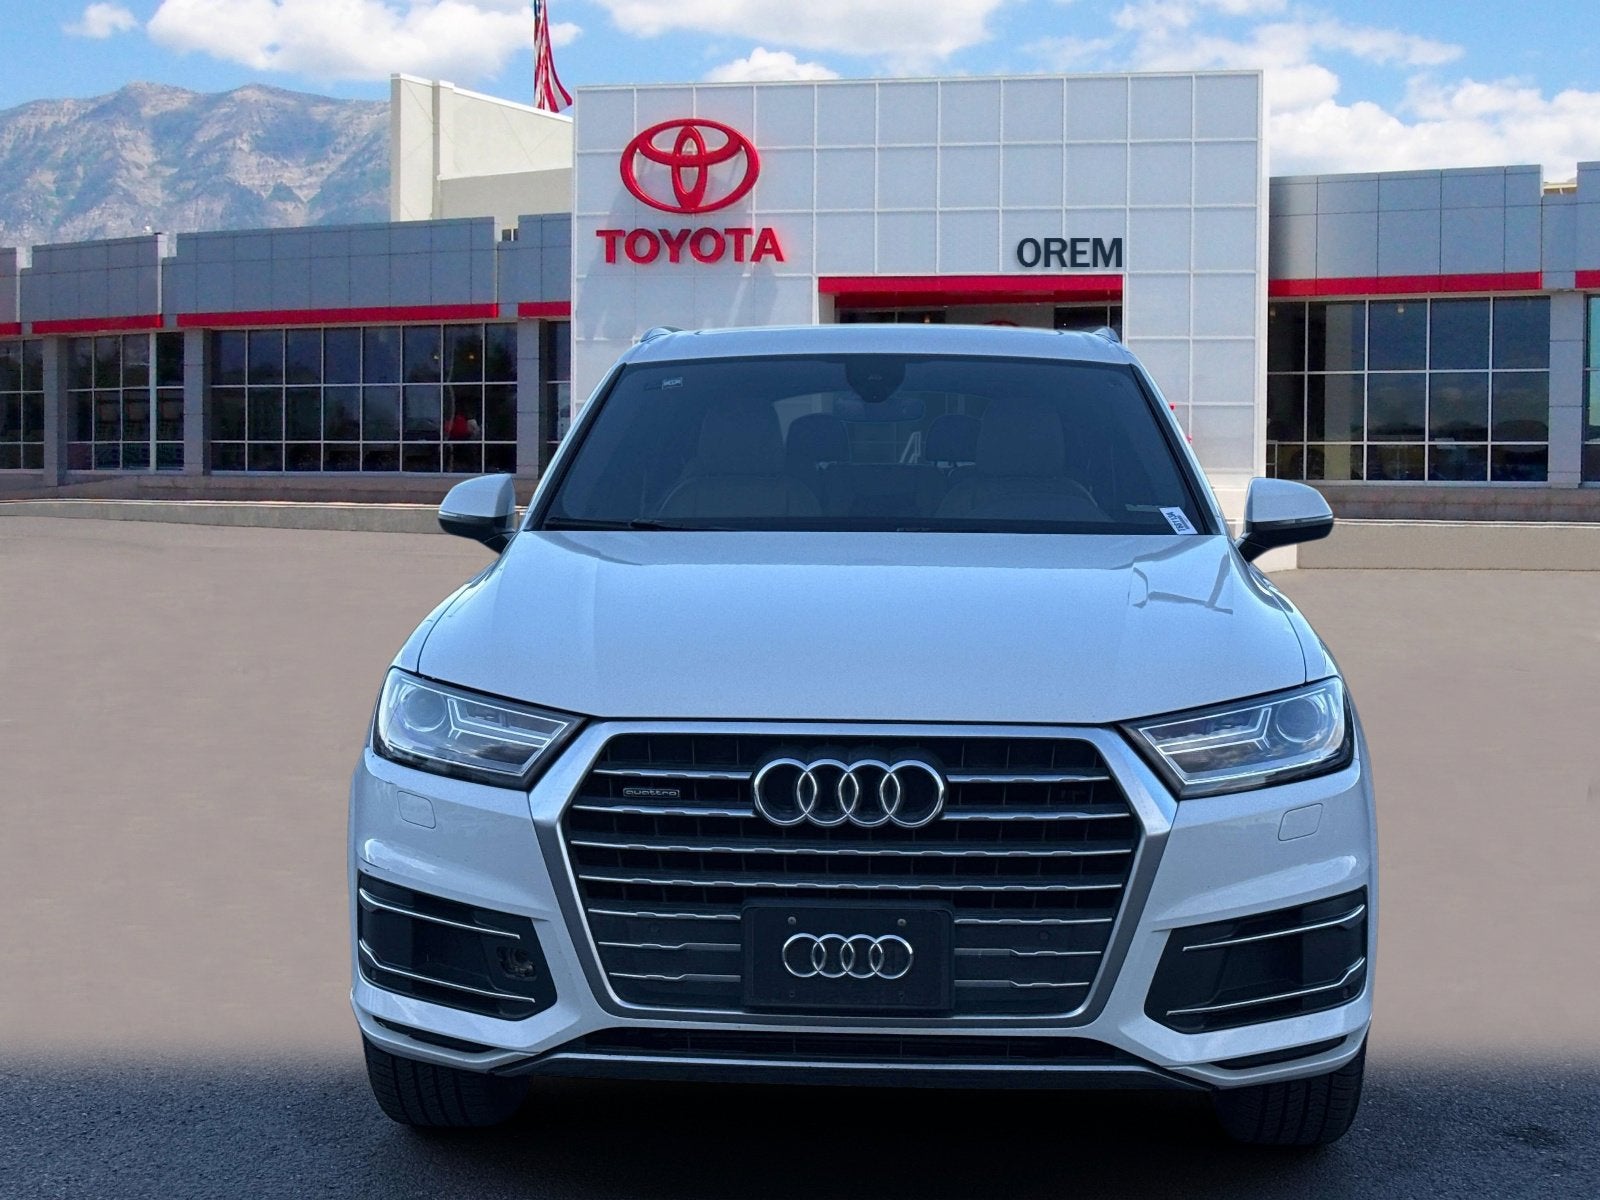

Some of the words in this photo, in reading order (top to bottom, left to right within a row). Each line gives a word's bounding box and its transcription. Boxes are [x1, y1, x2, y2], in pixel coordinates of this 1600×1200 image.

[596, 227, 784, 264] TOYOTA
[1017, 238, 1123, 268] OREM
[624, 788, 678, 797] quattro
